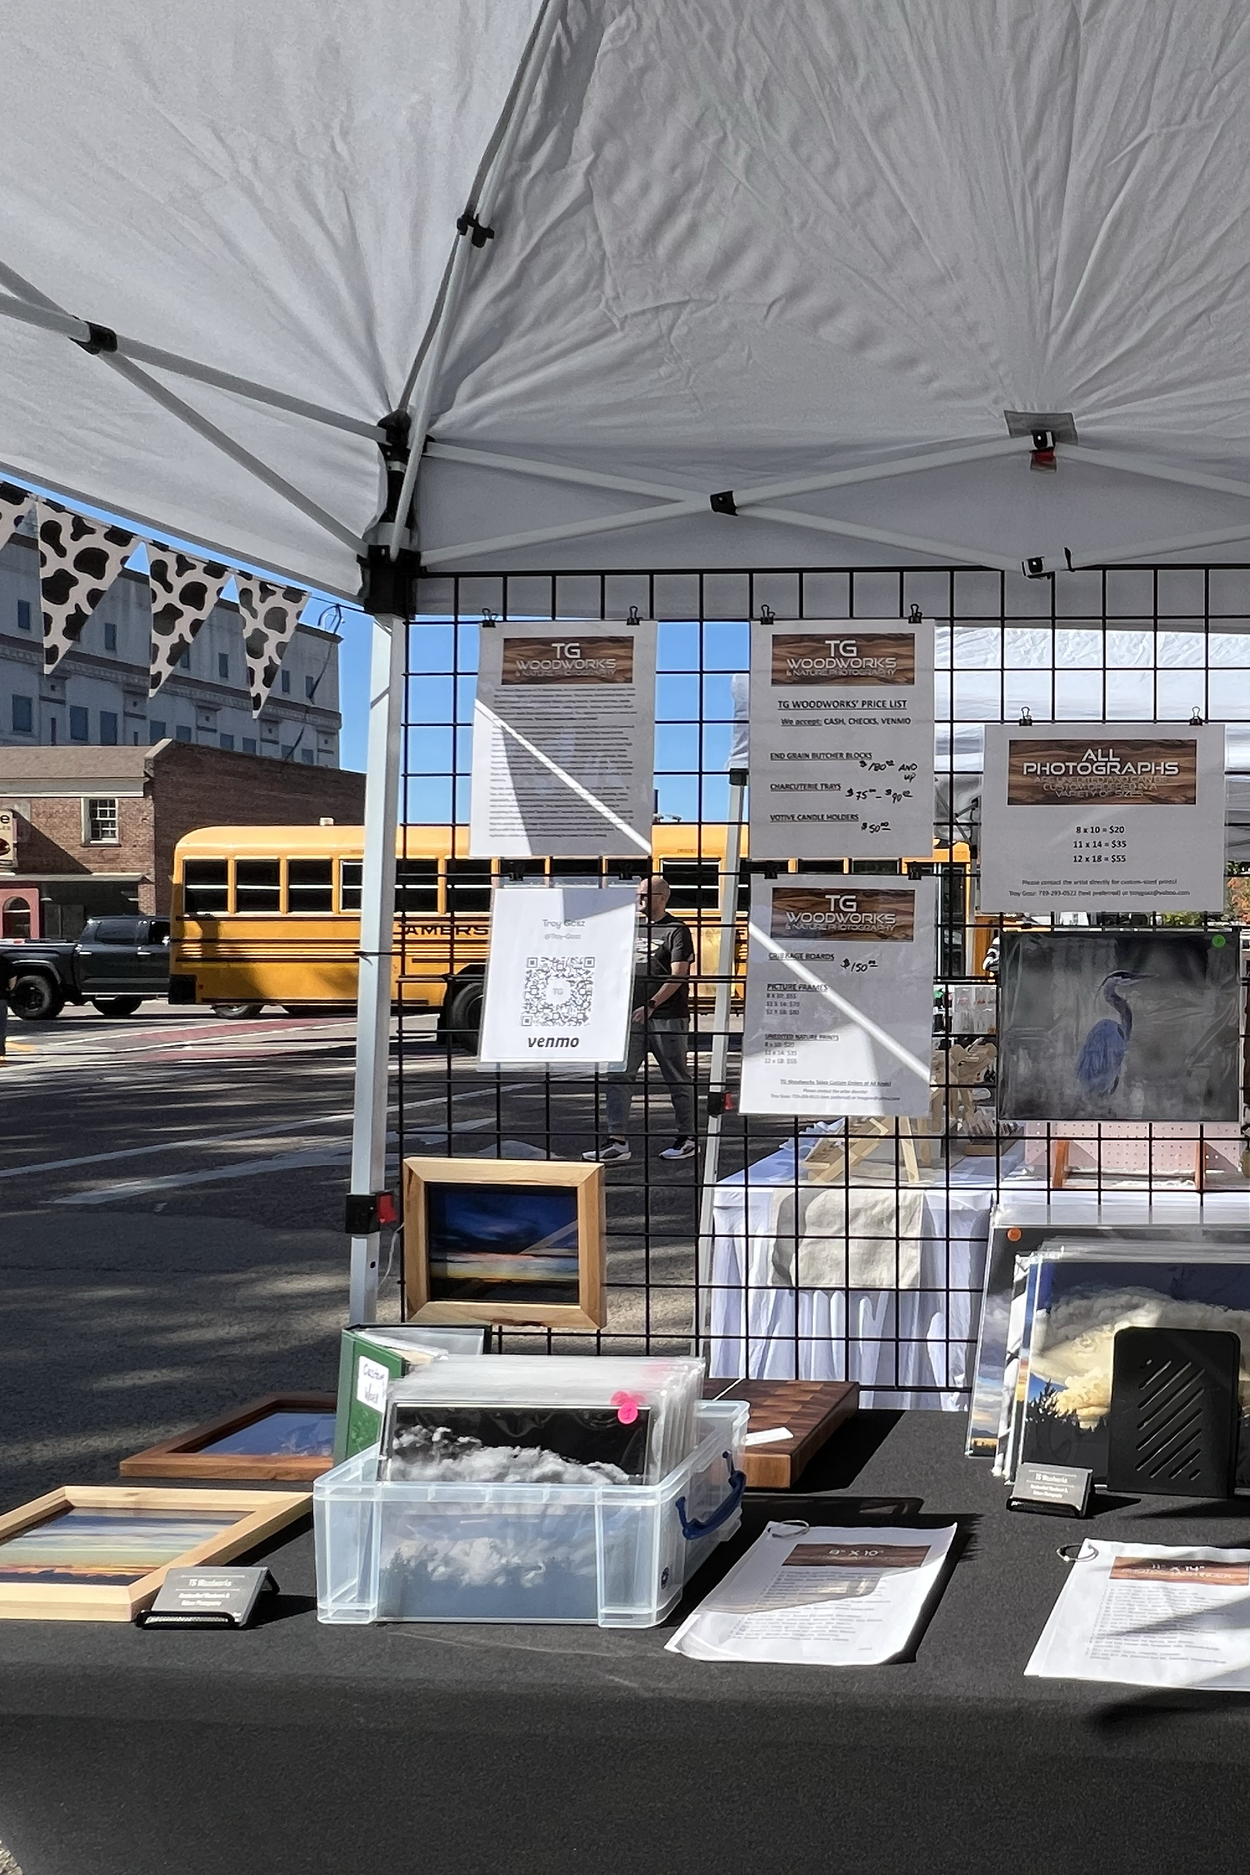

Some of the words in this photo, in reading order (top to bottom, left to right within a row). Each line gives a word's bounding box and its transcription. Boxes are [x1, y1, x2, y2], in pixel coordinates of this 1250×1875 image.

[551, 642, 581, 659] TG
[825, 640, 858, 657] TG
[515, 658, 617, 670] WOODWORKS
[786, 657, 897, 669] WOODWORKS
[792, 669, 828, 677] NATURE
[829, 668, 897, 677] PHOTOGRAPHY
[777, 700, 790, 709] TG
[861, 700, 887, 708] PRICE
[889, 700, 907, 708] LIST
[780, 718, 794, 726] We
[823, 717, 846, 726] CASH,
[880, 717, 912, 725] VENMO
[770, 752, 786, 760] END
[786, 752, 810, 760] GRAIN
[811, 752, 844, 760] BUTCHER
[845, 752, 872, 760] BLOCKS
[1081, 748, 1120, 761] ALL
[1023, 762, 1179, 775] PHOTOGRAPHS
[1106, 776, 1130, 784] AND
[1131, 776, 1152, 784] CAN
[770, 783, 818, 791] CHARCUTERIE
[820, 783, 841, 791] TRAYS
[1043, 783, 1086, 791] CUSTOM
[1055, 790, 1098, 798] VARIETY
[770, 814, 795, 822] VOTIVE
[796, 814, 824, 822] CANDLE
[826, 814, 859, 822] HOLDERS
[1076, 826, 1082, 834] 8
[1090, 826, 1100, 834] 10
[1109, 825, 1125, 835] $20
[1073, 840, 1083, 848] 11
[1092, 840, 1102, 848] 14
[1111, 839, 1127, 849] $35
[1073, 855, 1083, 863] 12
[1092, 855, 1102, 863] 18
[1111, 854, 1127, 864] $55
[825, 894, 858, 912] TG
[786, 912, 896, 924] WOODWORKS
[542, 919, 562, 929] Troy
[392, 924, 489, 936] AMERS
[527, 1036, 580, 1048] venmo
